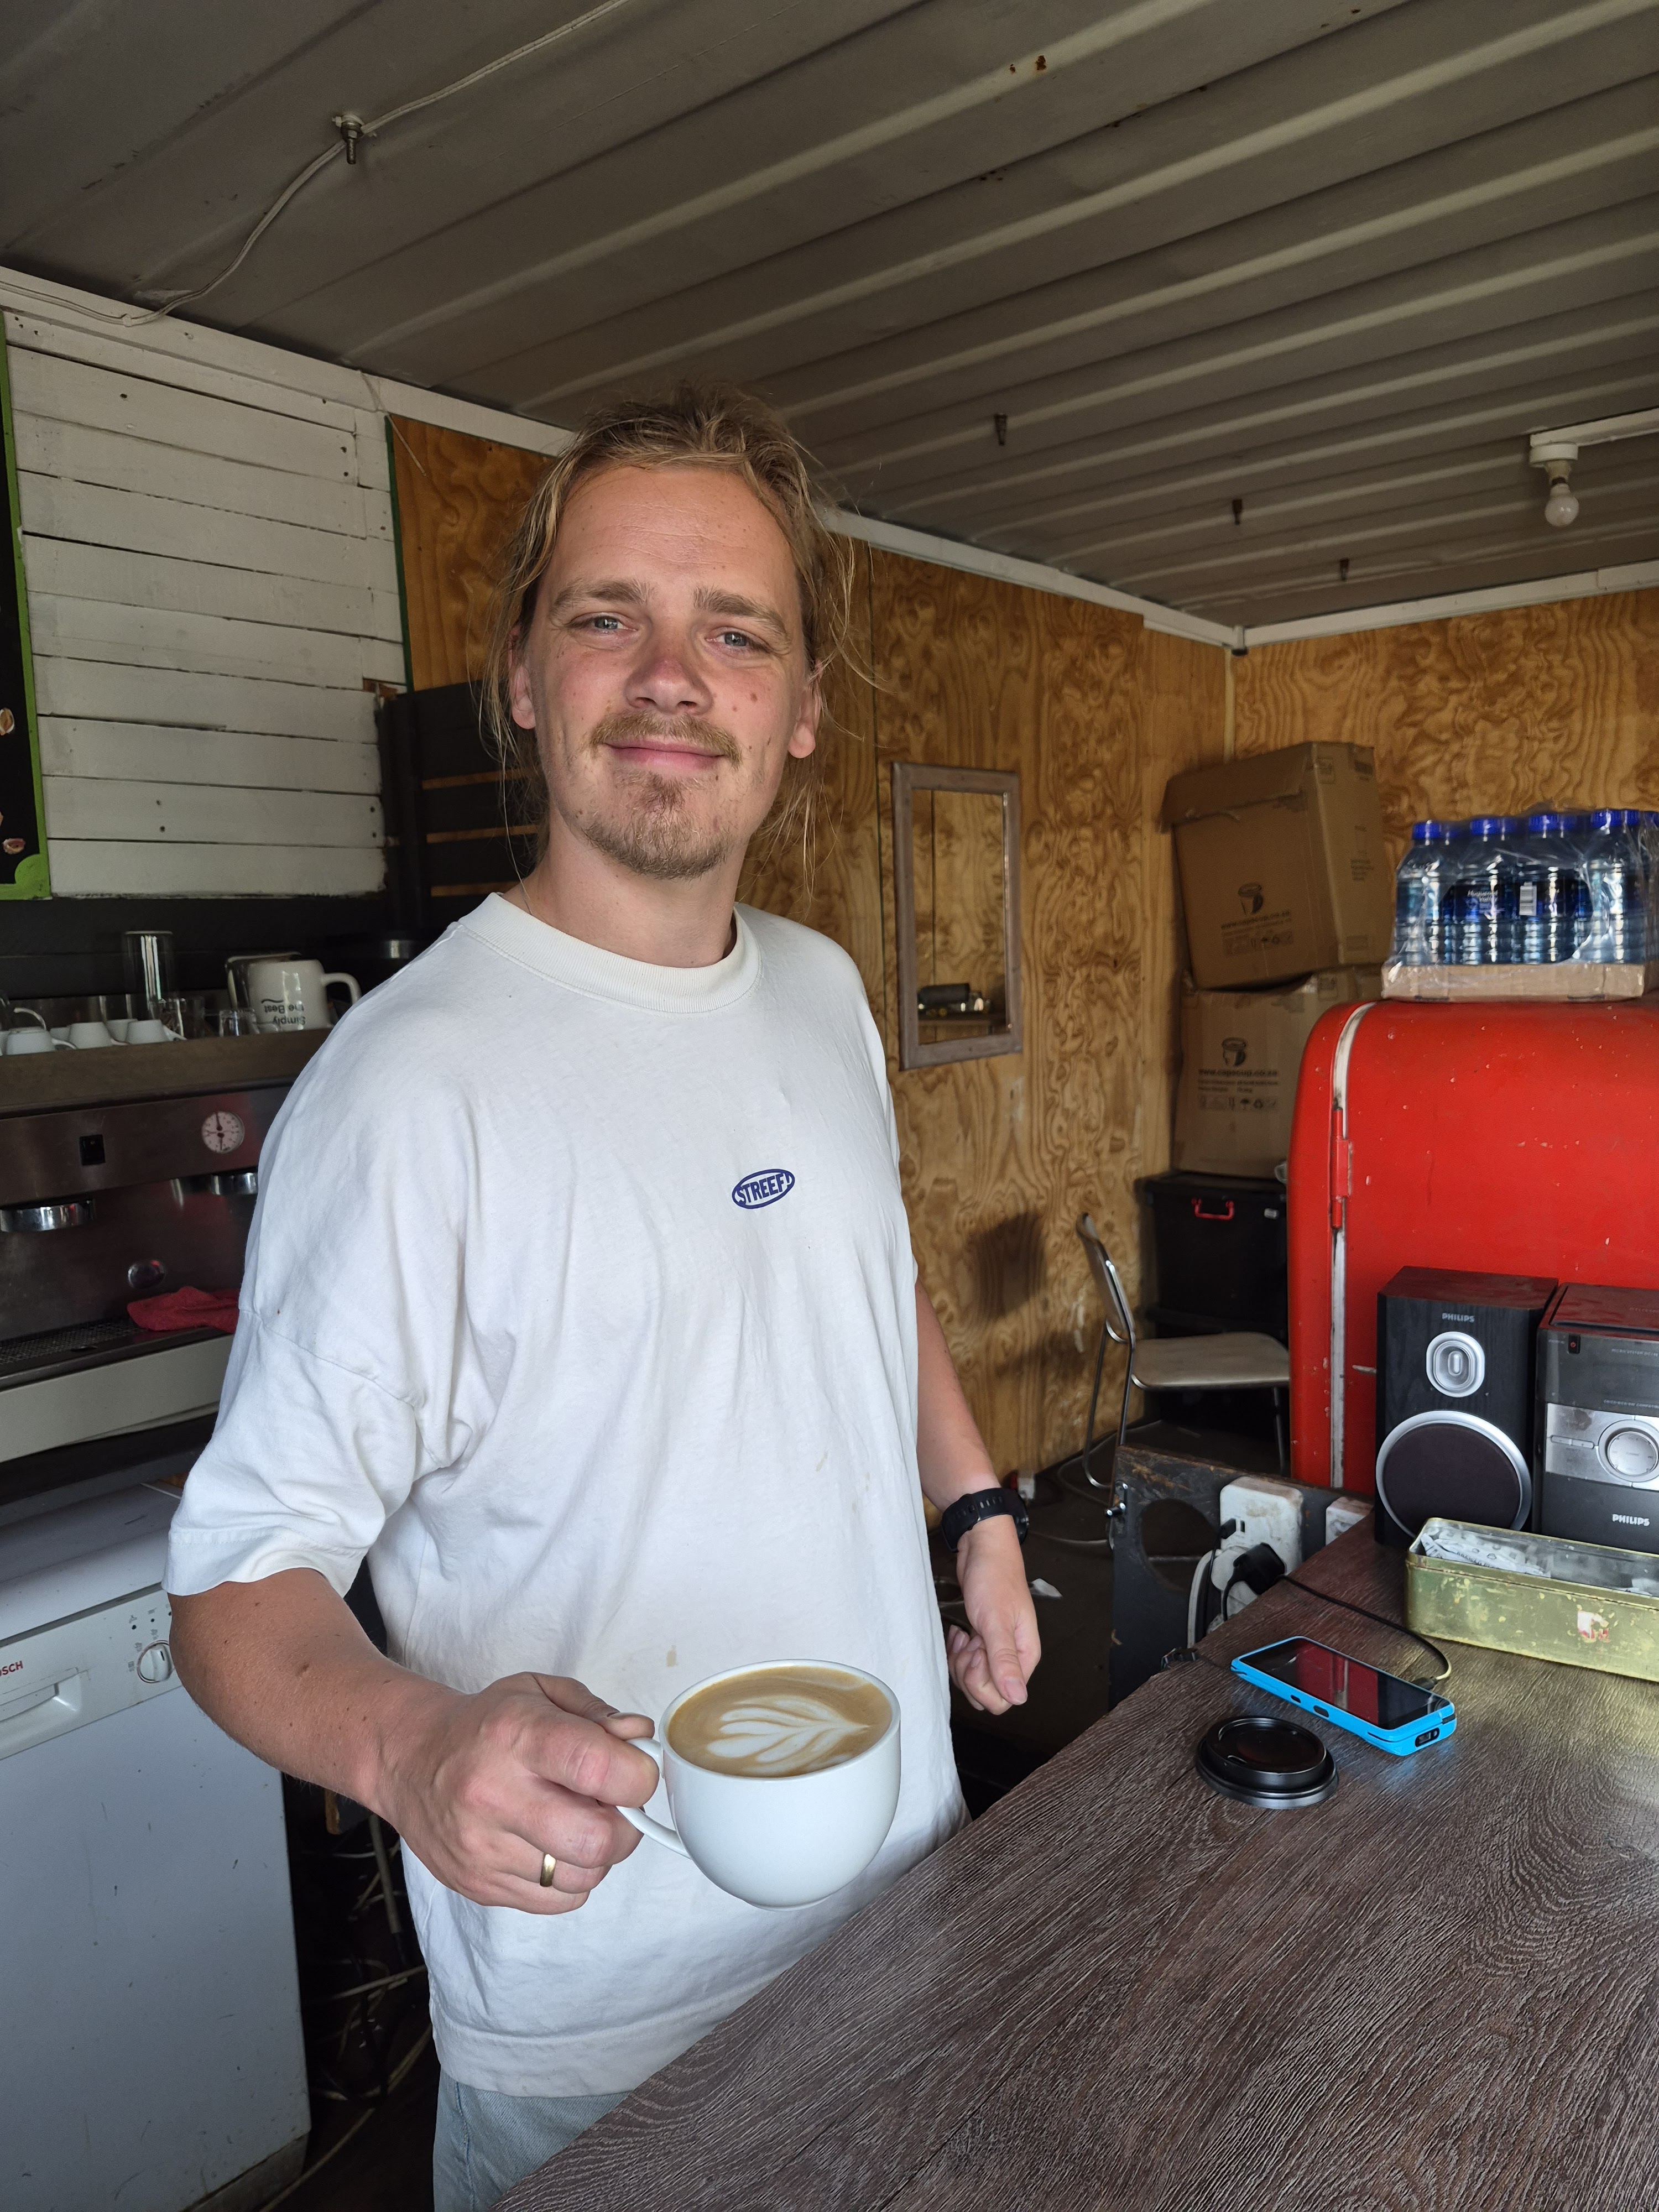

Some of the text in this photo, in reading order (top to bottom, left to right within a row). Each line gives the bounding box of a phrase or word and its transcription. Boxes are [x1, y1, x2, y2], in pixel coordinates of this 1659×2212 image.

[264, 1004, 285, 1014] Best
[273, 1016, 305, 1029] Simply
[1442, 1312, 1475, 1323] PHILIPS
[1612, 1514, 1650, 1526] PHILIPS
[0, 1661, 23, 1676] SCH
